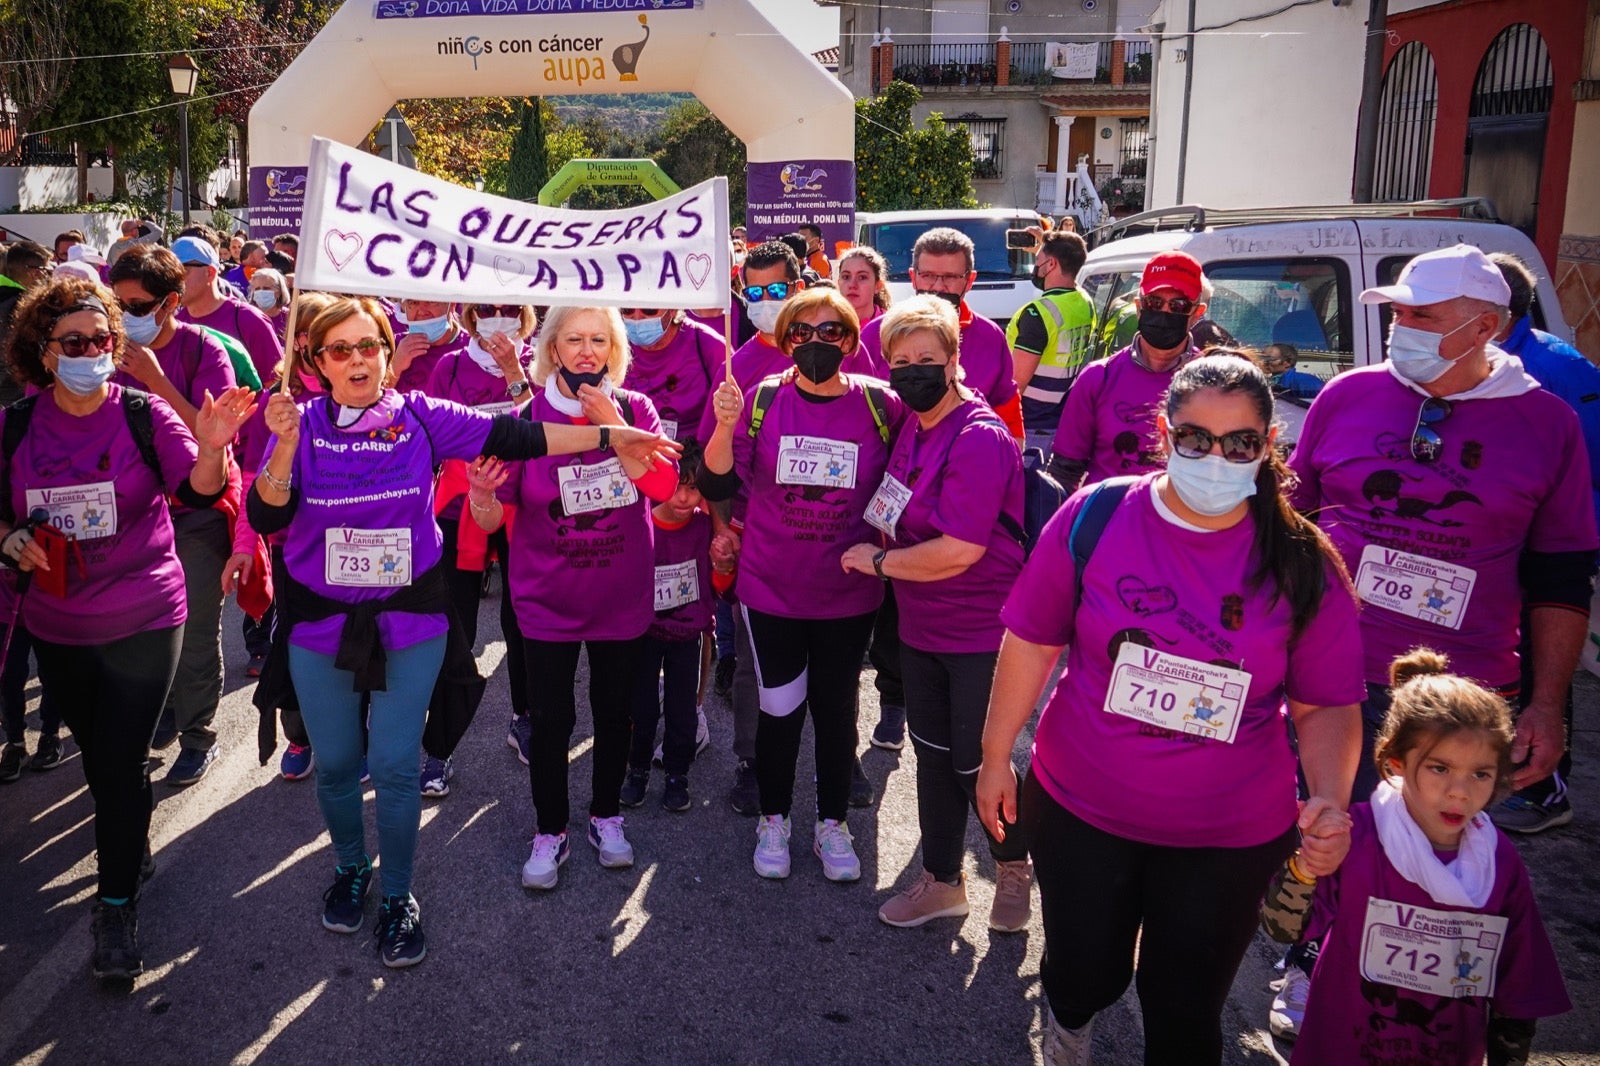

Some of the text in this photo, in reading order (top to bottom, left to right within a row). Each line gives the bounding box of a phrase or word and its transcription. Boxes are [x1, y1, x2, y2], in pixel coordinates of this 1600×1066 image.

[499, 40, 533, 53] con
[538, 34, 604, 53] cáncer
[543, 57, 606, 86] aupa
[586, 162, 638, 172] Diputación
[586, 172, 638, 181] de Granada
[335, 162, 439, 228] LAS
[796, 200, 826, 209] leucemia
[754, 215, 772, 225] DONA
[813, 214, 836, 224] DONA
[365, 233, 683, 292] CON AUPA
[794, 437, 805, 449] V
[572, 467, 583, 479] V
[789, 459, 819, 475] 707
[41, 490, 86, 503] V CARRERA
[307, 487, 421, 507] www.ponteenmarchaya.org
[572, 487, 603, 503] 713
[871, 497, 887, 517] 705
[49, 514, 75, 530] 06
[343, 529, 354, 543] V
[339, 555, 371, 572] 733
[1384, 550, 1399, 566] V
[1395, 560, 1438, 577] CARRERA
[1371, 575, 1413, 601] 708
[1144, 649, 1161, 669] V
[1156, 664, 1206, 683] CARRERA
[1129, 682, 1177, 712] 710
[1396, 904, 1416, 928] V
[1413, 921, 1463, 936] CARRERA
[1384, 943, 1442, 977] 712
[1391, 969, 1418, 982] DAVID
